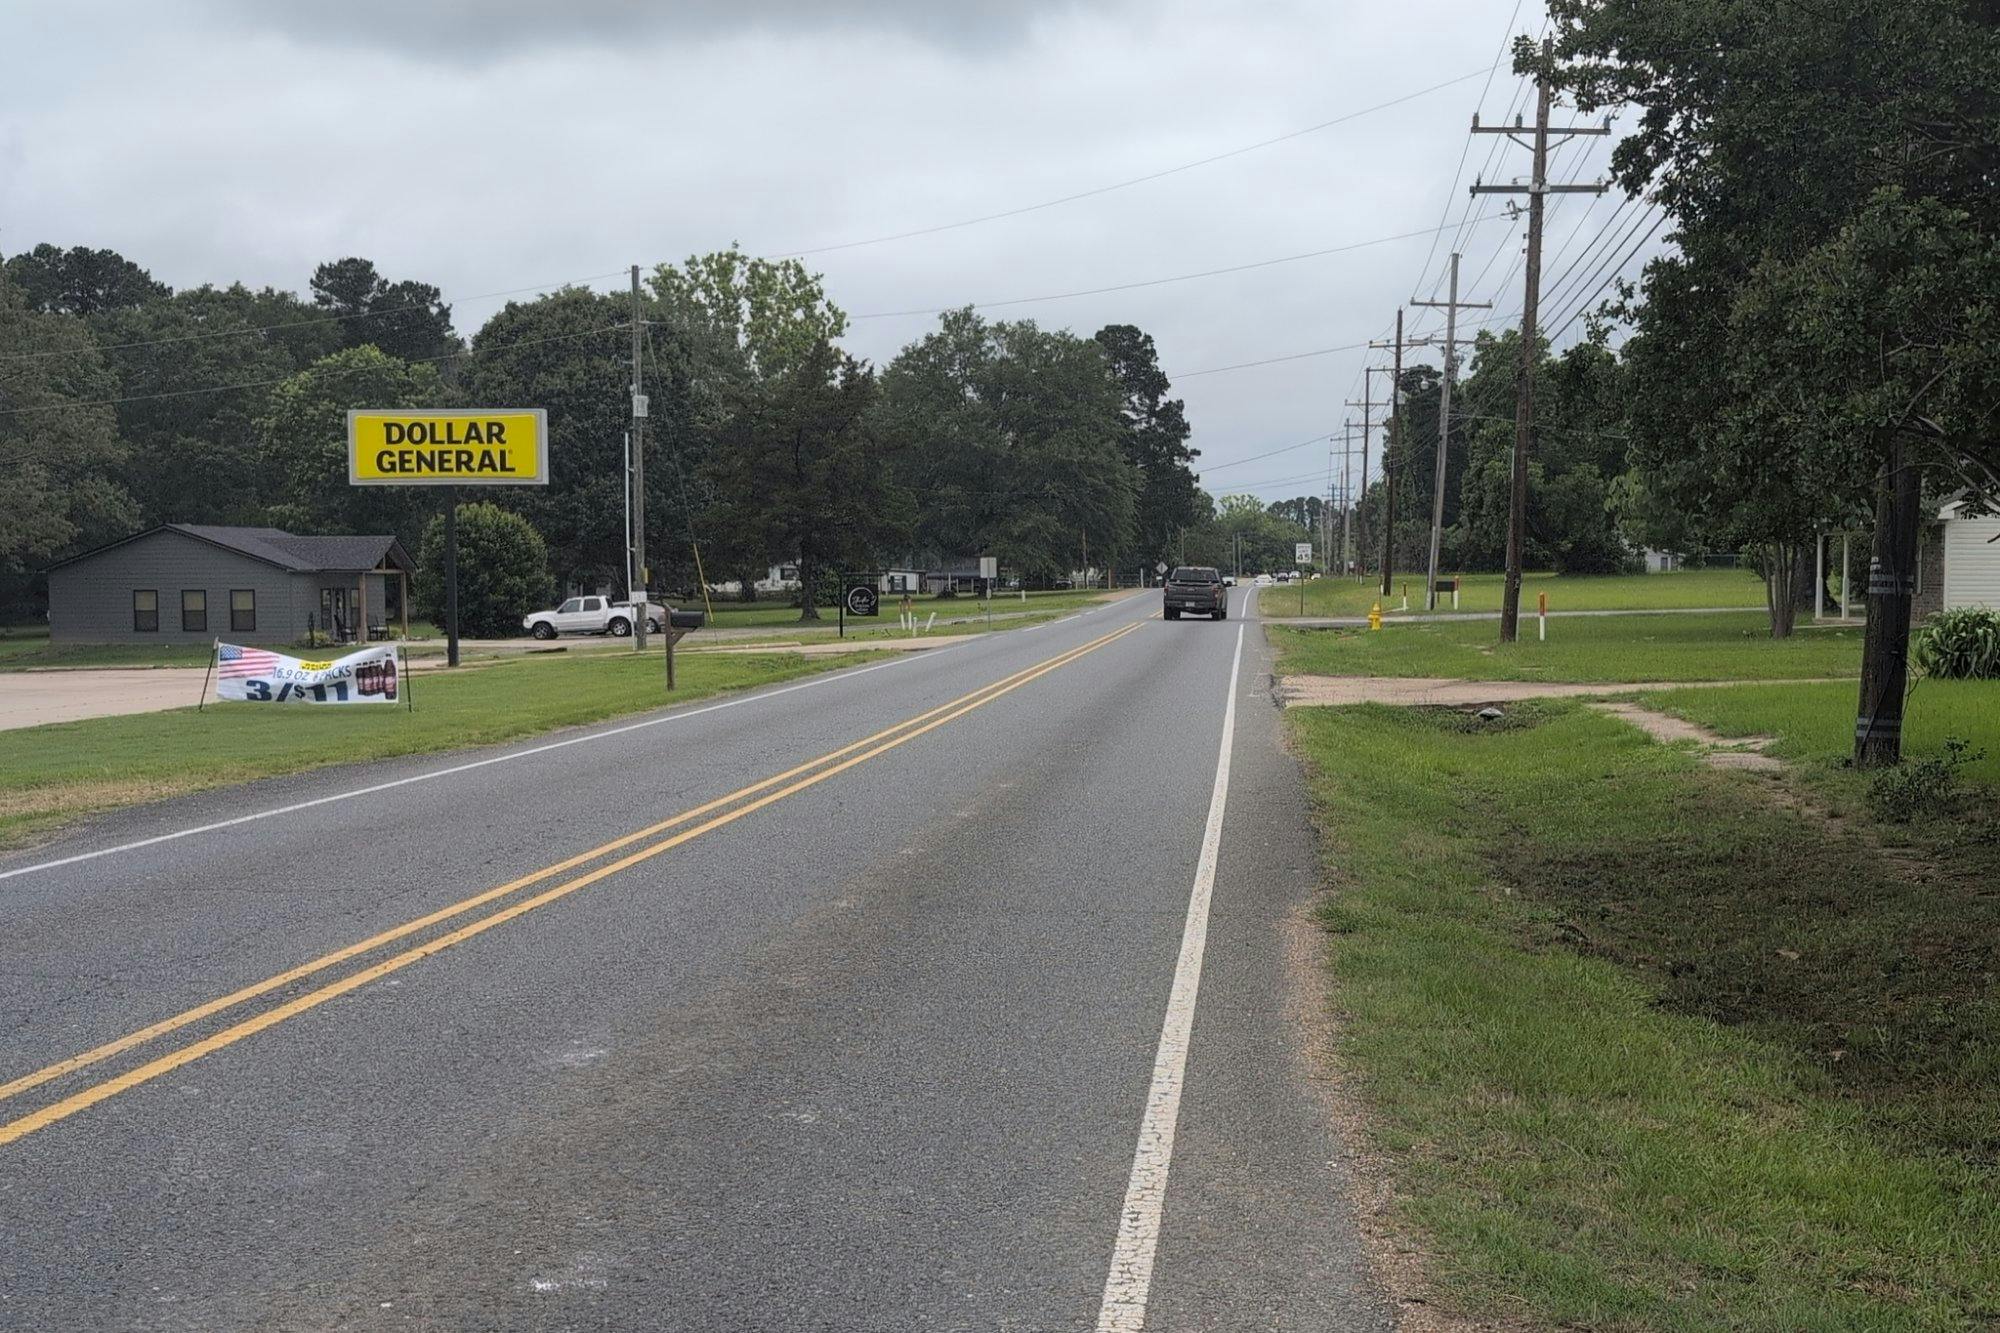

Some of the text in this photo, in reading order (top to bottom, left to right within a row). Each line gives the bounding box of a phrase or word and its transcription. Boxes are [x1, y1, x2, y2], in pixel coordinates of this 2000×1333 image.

[383, 422, 507, 445] DOLLAR
[376, 450, 516, 473] GENERAL
[294, 671, 309, 680] OZ
[246, 680, 348, 702] 3/$11
